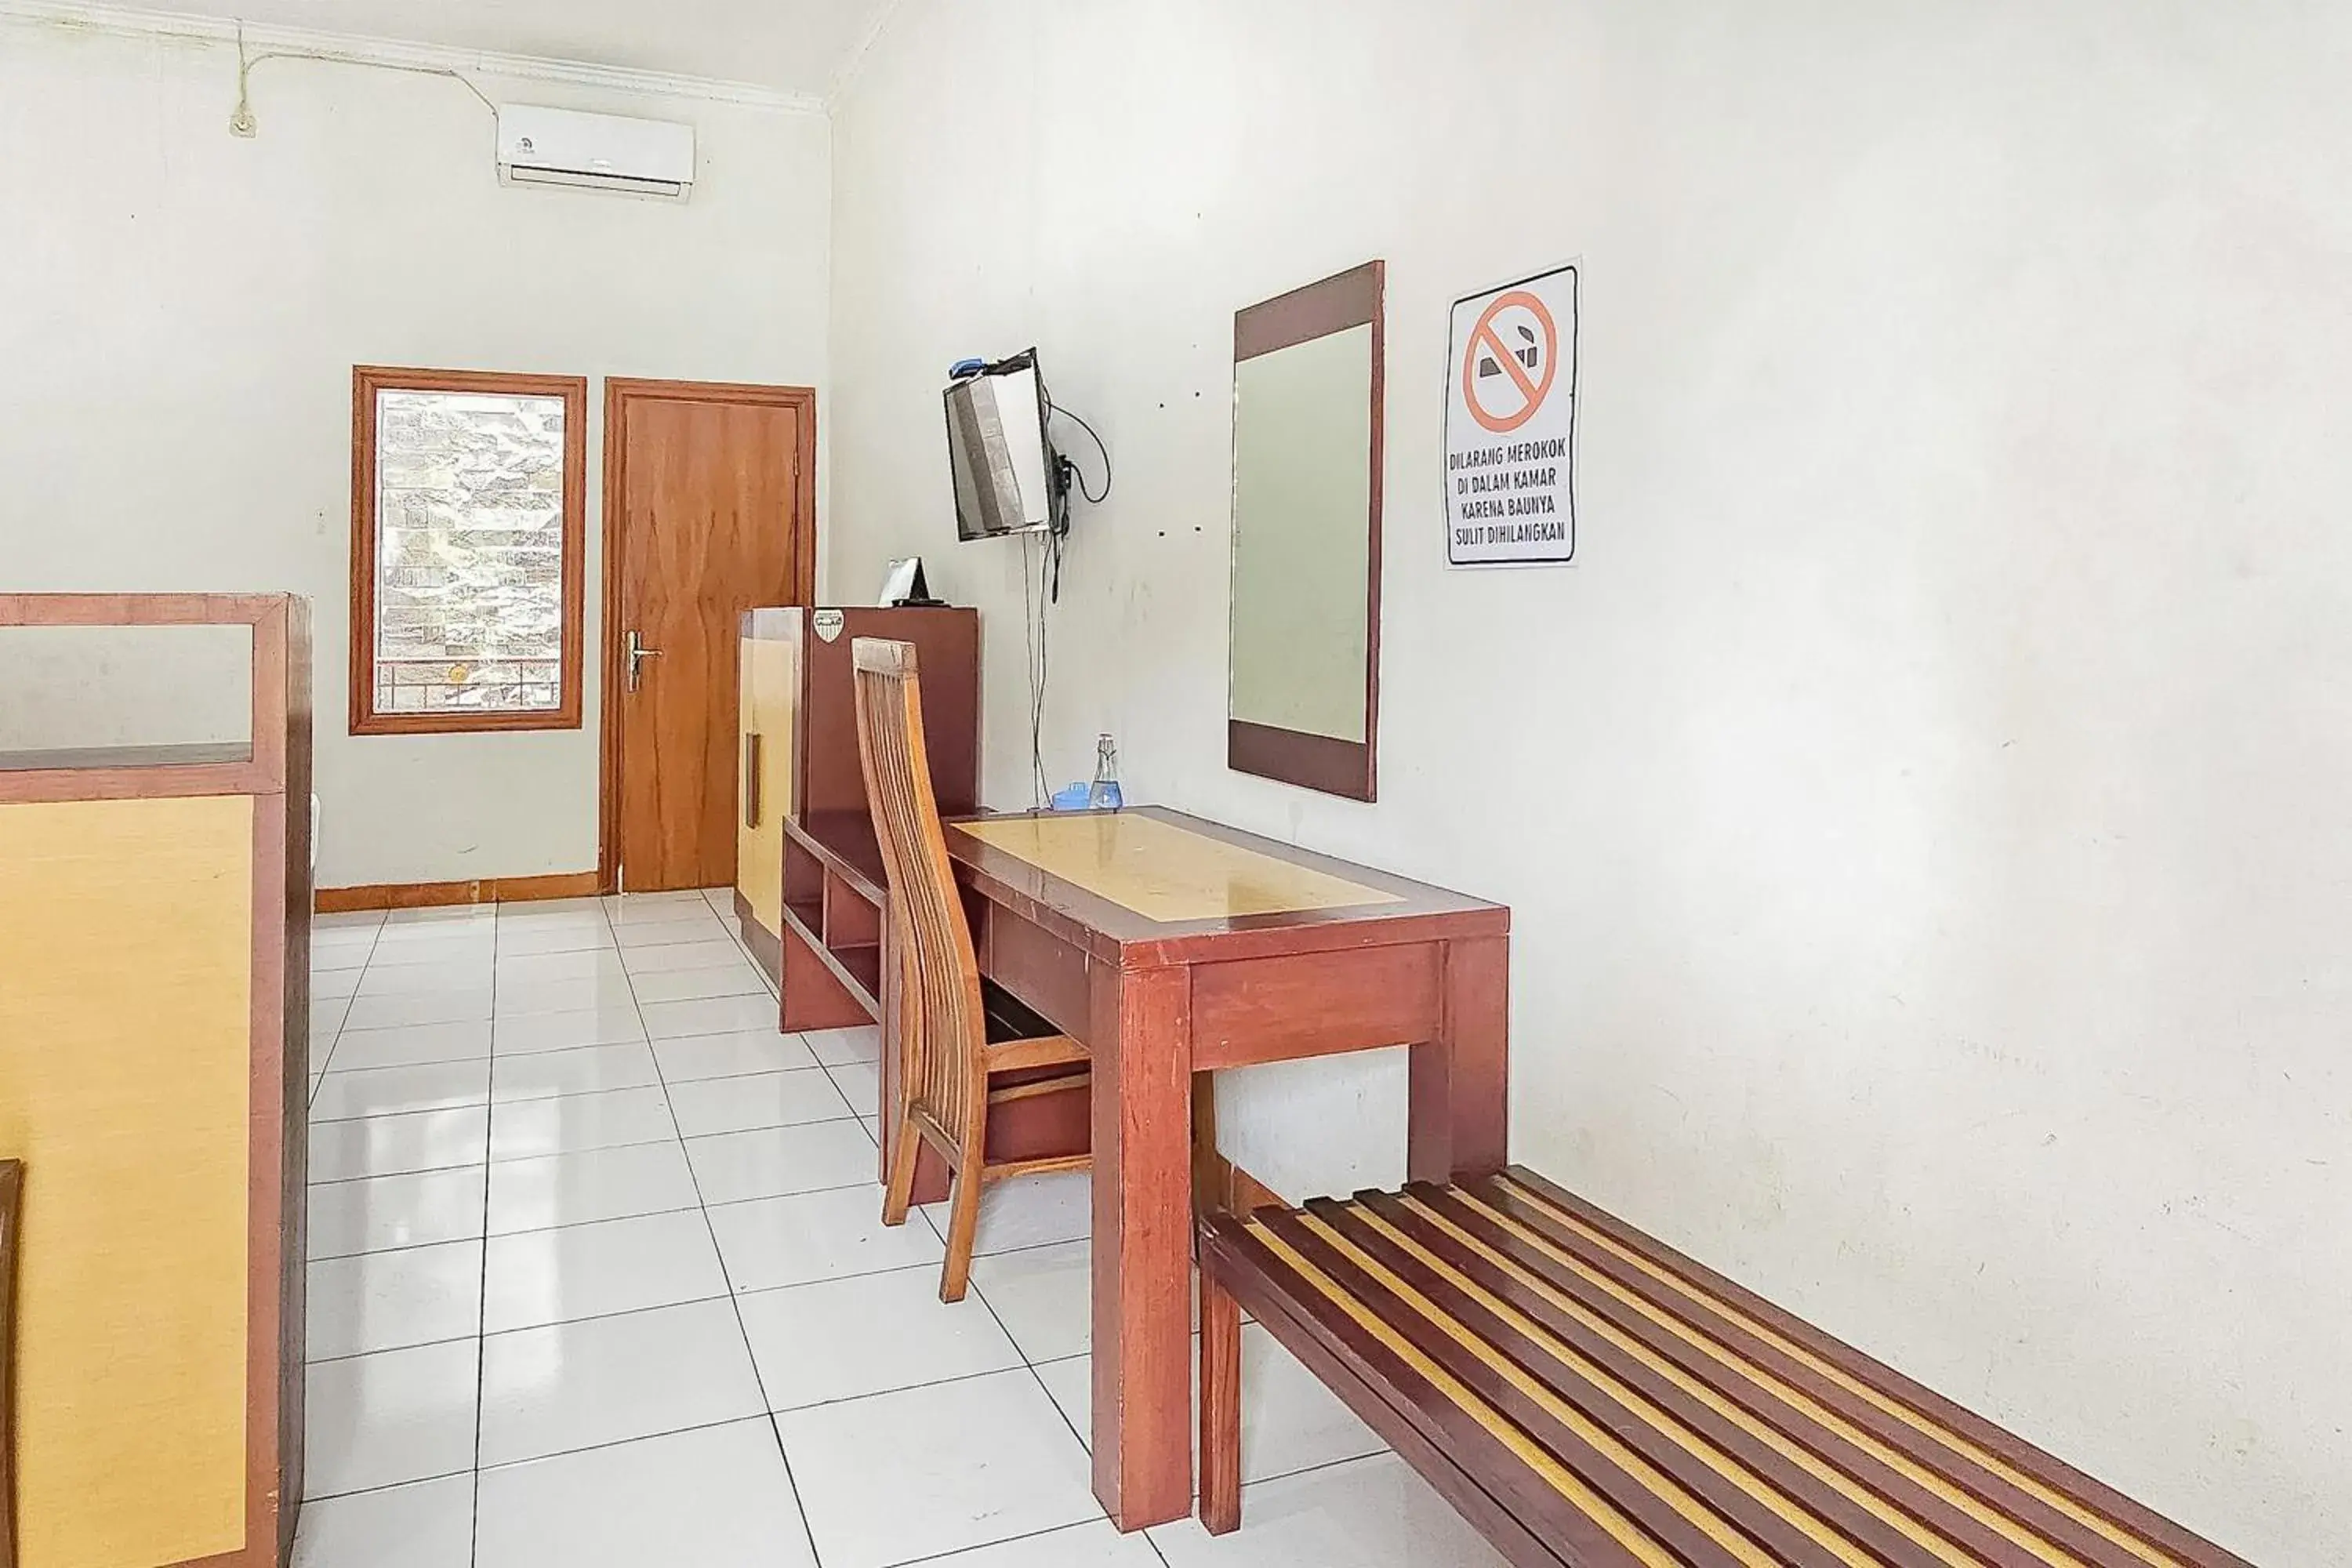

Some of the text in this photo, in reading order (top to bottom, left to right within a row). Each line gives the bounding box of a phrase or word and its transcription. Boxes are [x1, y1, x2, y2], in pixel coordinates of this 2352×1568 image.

[1450, 437, 1566, 470] DILARANG MEROKOK
[1457, 467, 1556, 495] DI DALAM KAMAR
[1461, 495, 1555, 519] KARENA BAUNYA
[1456, 522, 1565, 546] SULIT DIHILANGKAN
